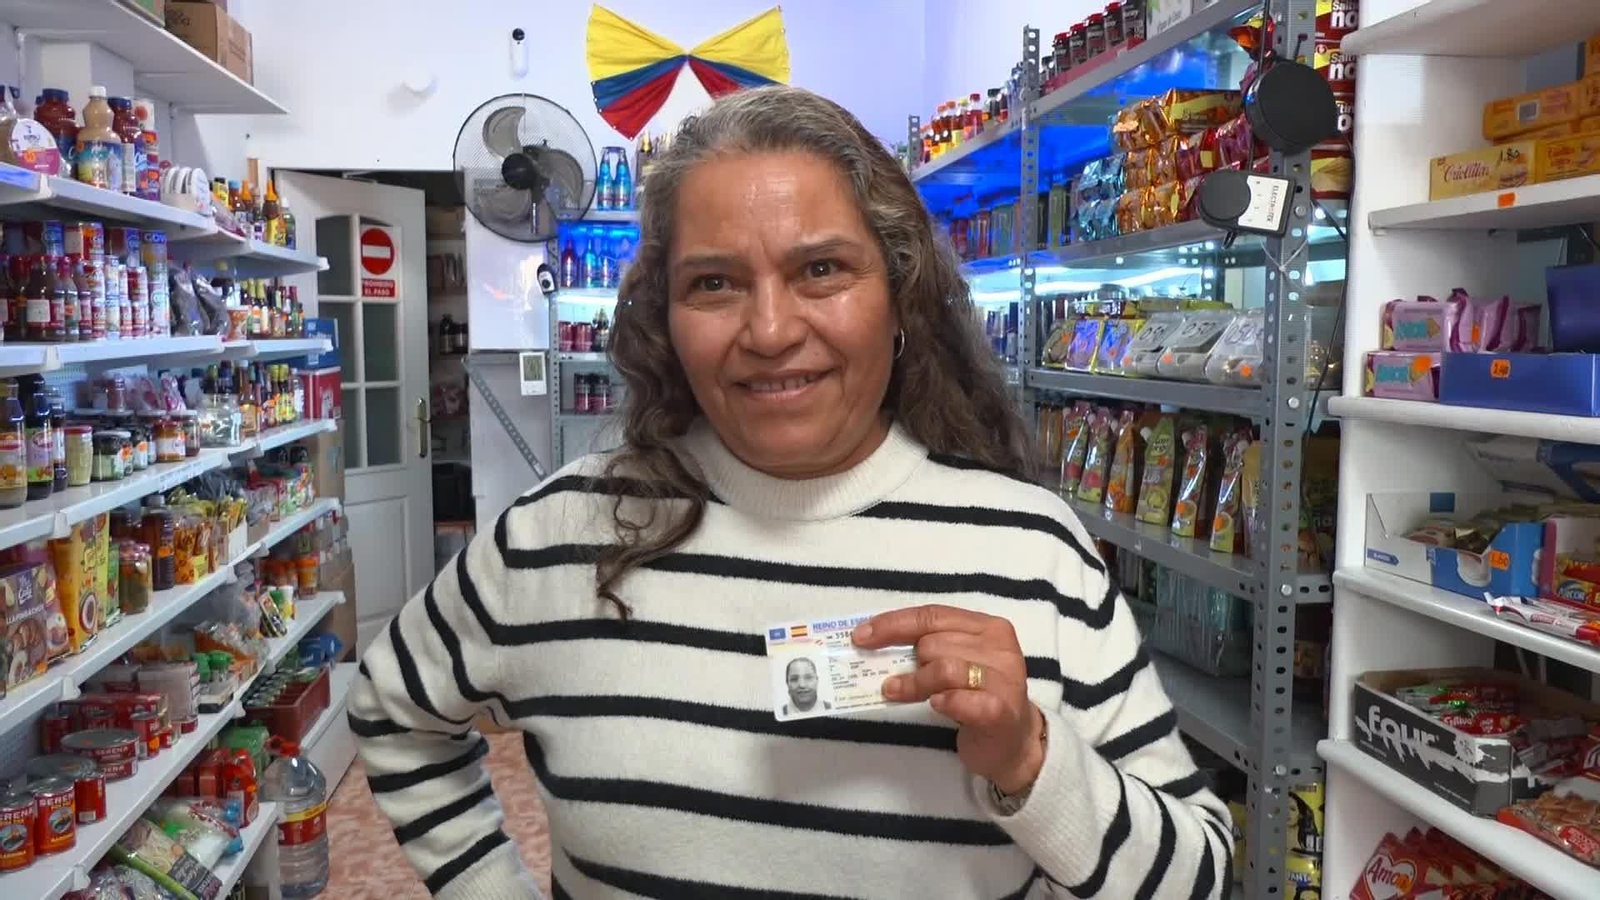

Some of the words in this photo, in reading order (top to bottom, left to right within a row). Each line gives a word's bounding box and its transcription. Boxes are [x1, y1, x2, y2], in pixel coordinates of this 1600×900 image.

[1331, 12, 1358, 28] no
[1329, 64, 1356, 81] no
[39, 794, 76, 806] SEREN
[0, 808, 34, 823] ERENA
